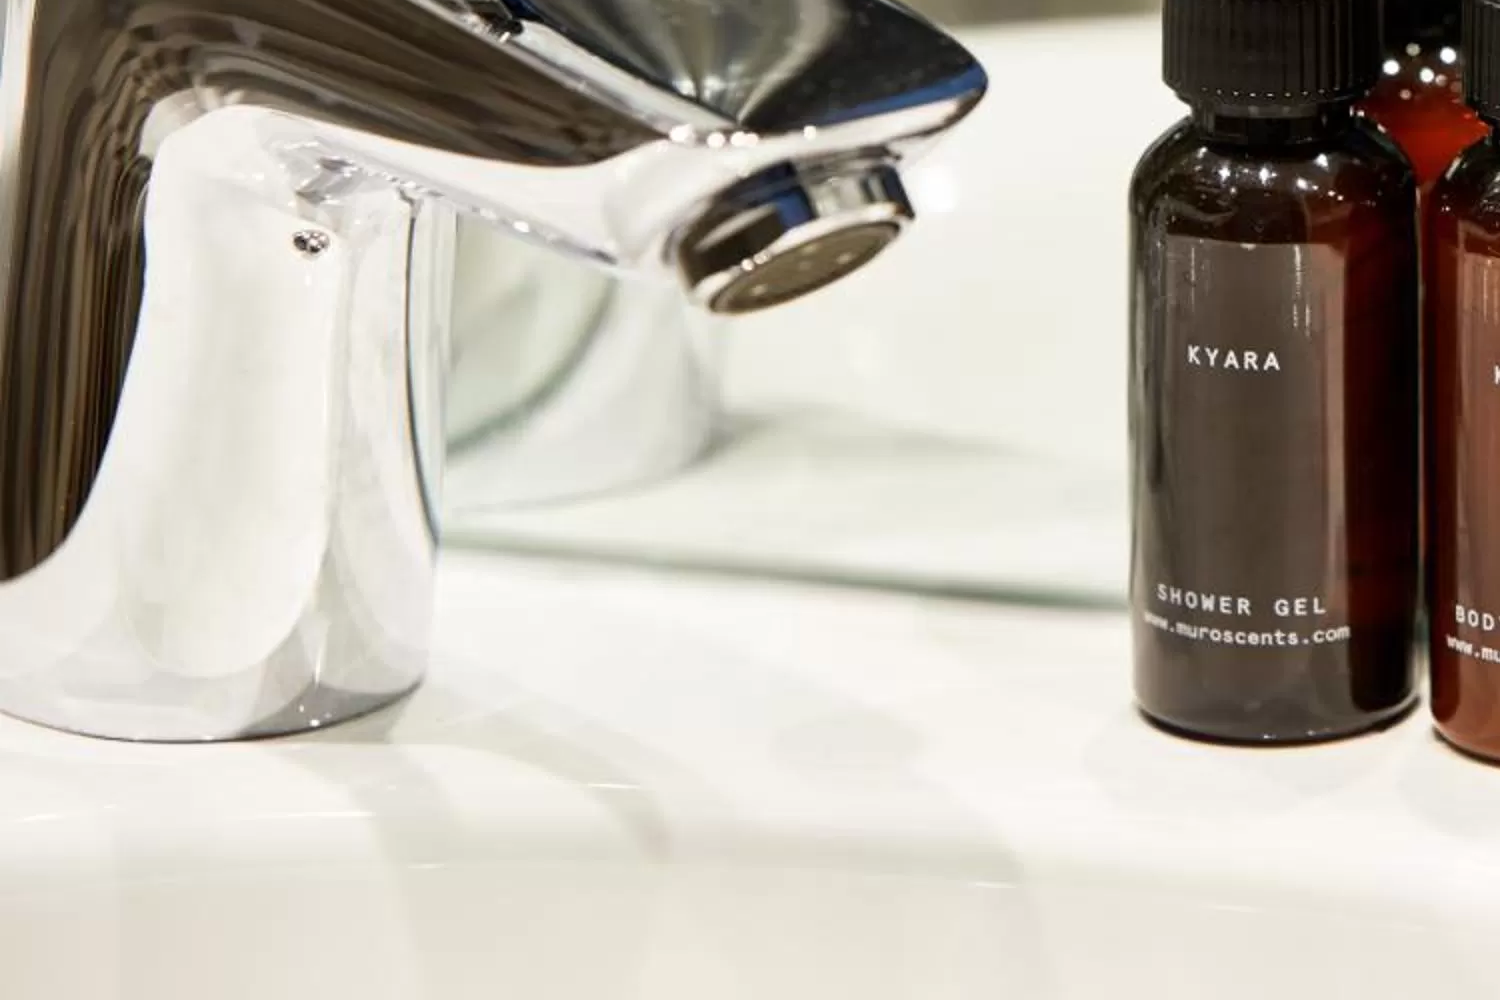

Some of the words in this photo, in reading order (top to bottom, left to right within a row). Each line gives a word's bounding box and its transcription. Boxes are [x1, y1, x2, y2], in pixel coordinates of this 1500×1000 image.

[1187, 345, 1281, 371] KYARA
[1156, 584, 1252, 615] SHOWER
[1274, 597, 1327, 617] GEL
[1144, 611, 1350, 645] www.muroscents.com
